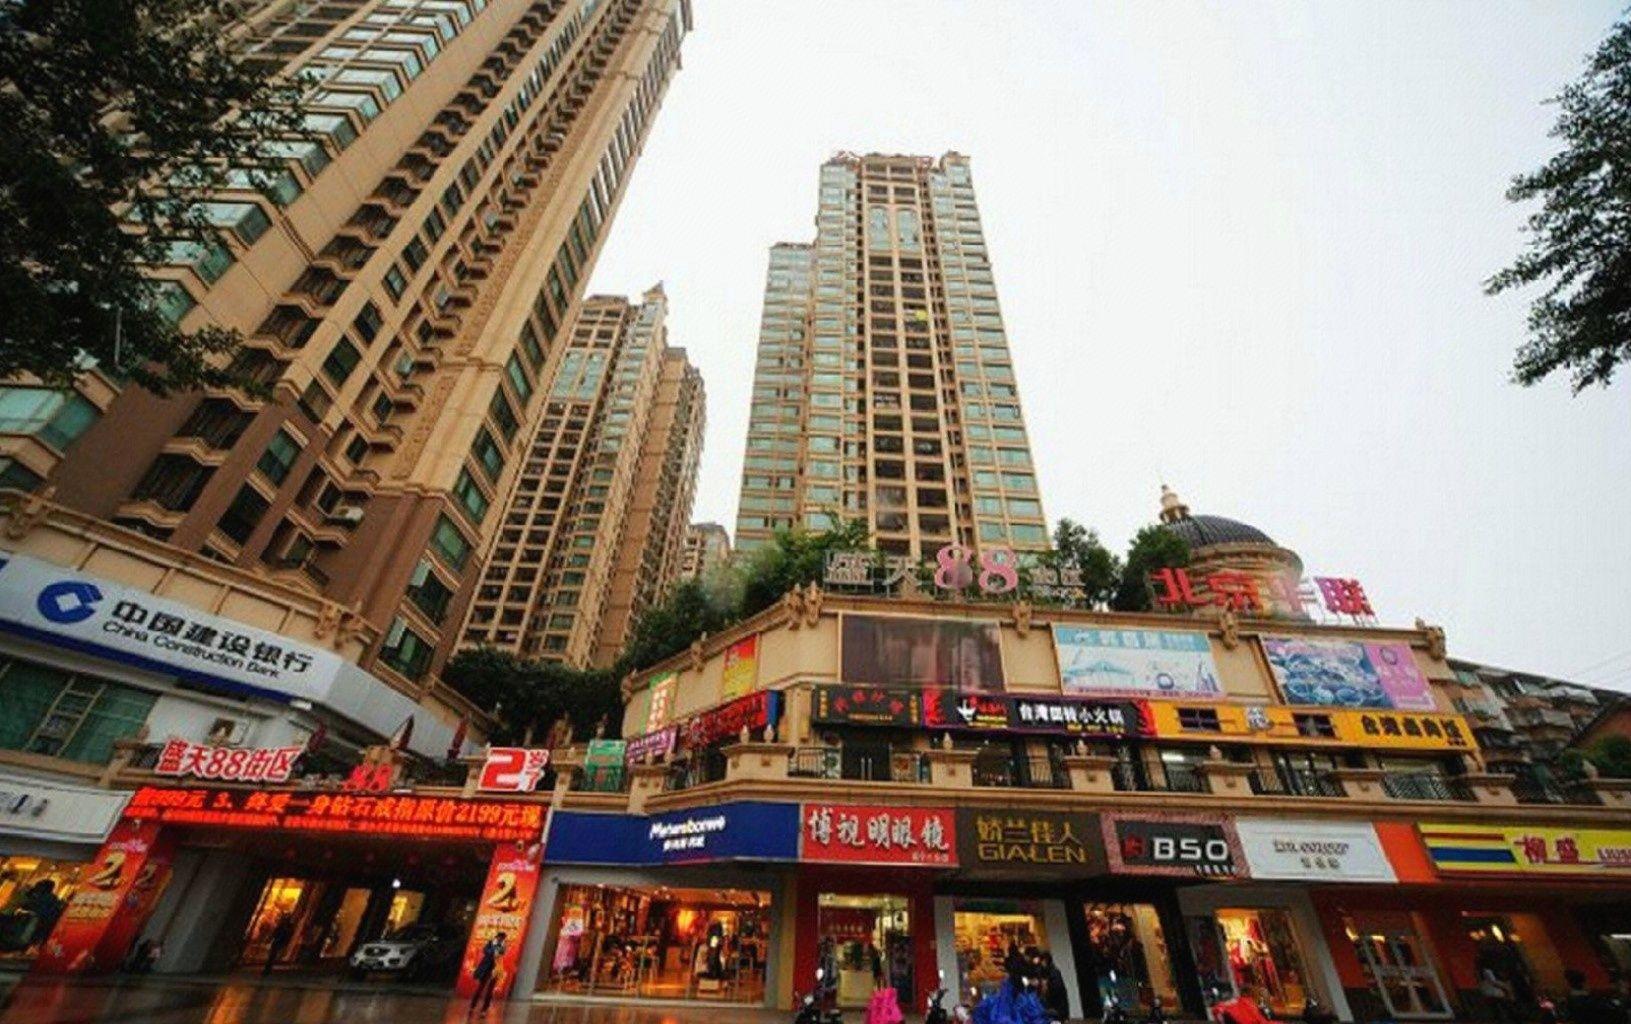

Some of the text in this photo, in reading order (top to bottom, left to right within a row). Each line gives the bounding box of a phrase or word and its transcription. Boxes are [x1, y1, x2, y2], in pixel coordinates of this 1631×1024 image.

[103, 621, 148, 641] China
[153, 634, 243, 669] Construction
[112, 601, 313, 673] 中国建设银行
[979, 842, 1087, 863] GIALEN
[1153, 837, 1228, 860] BSO
